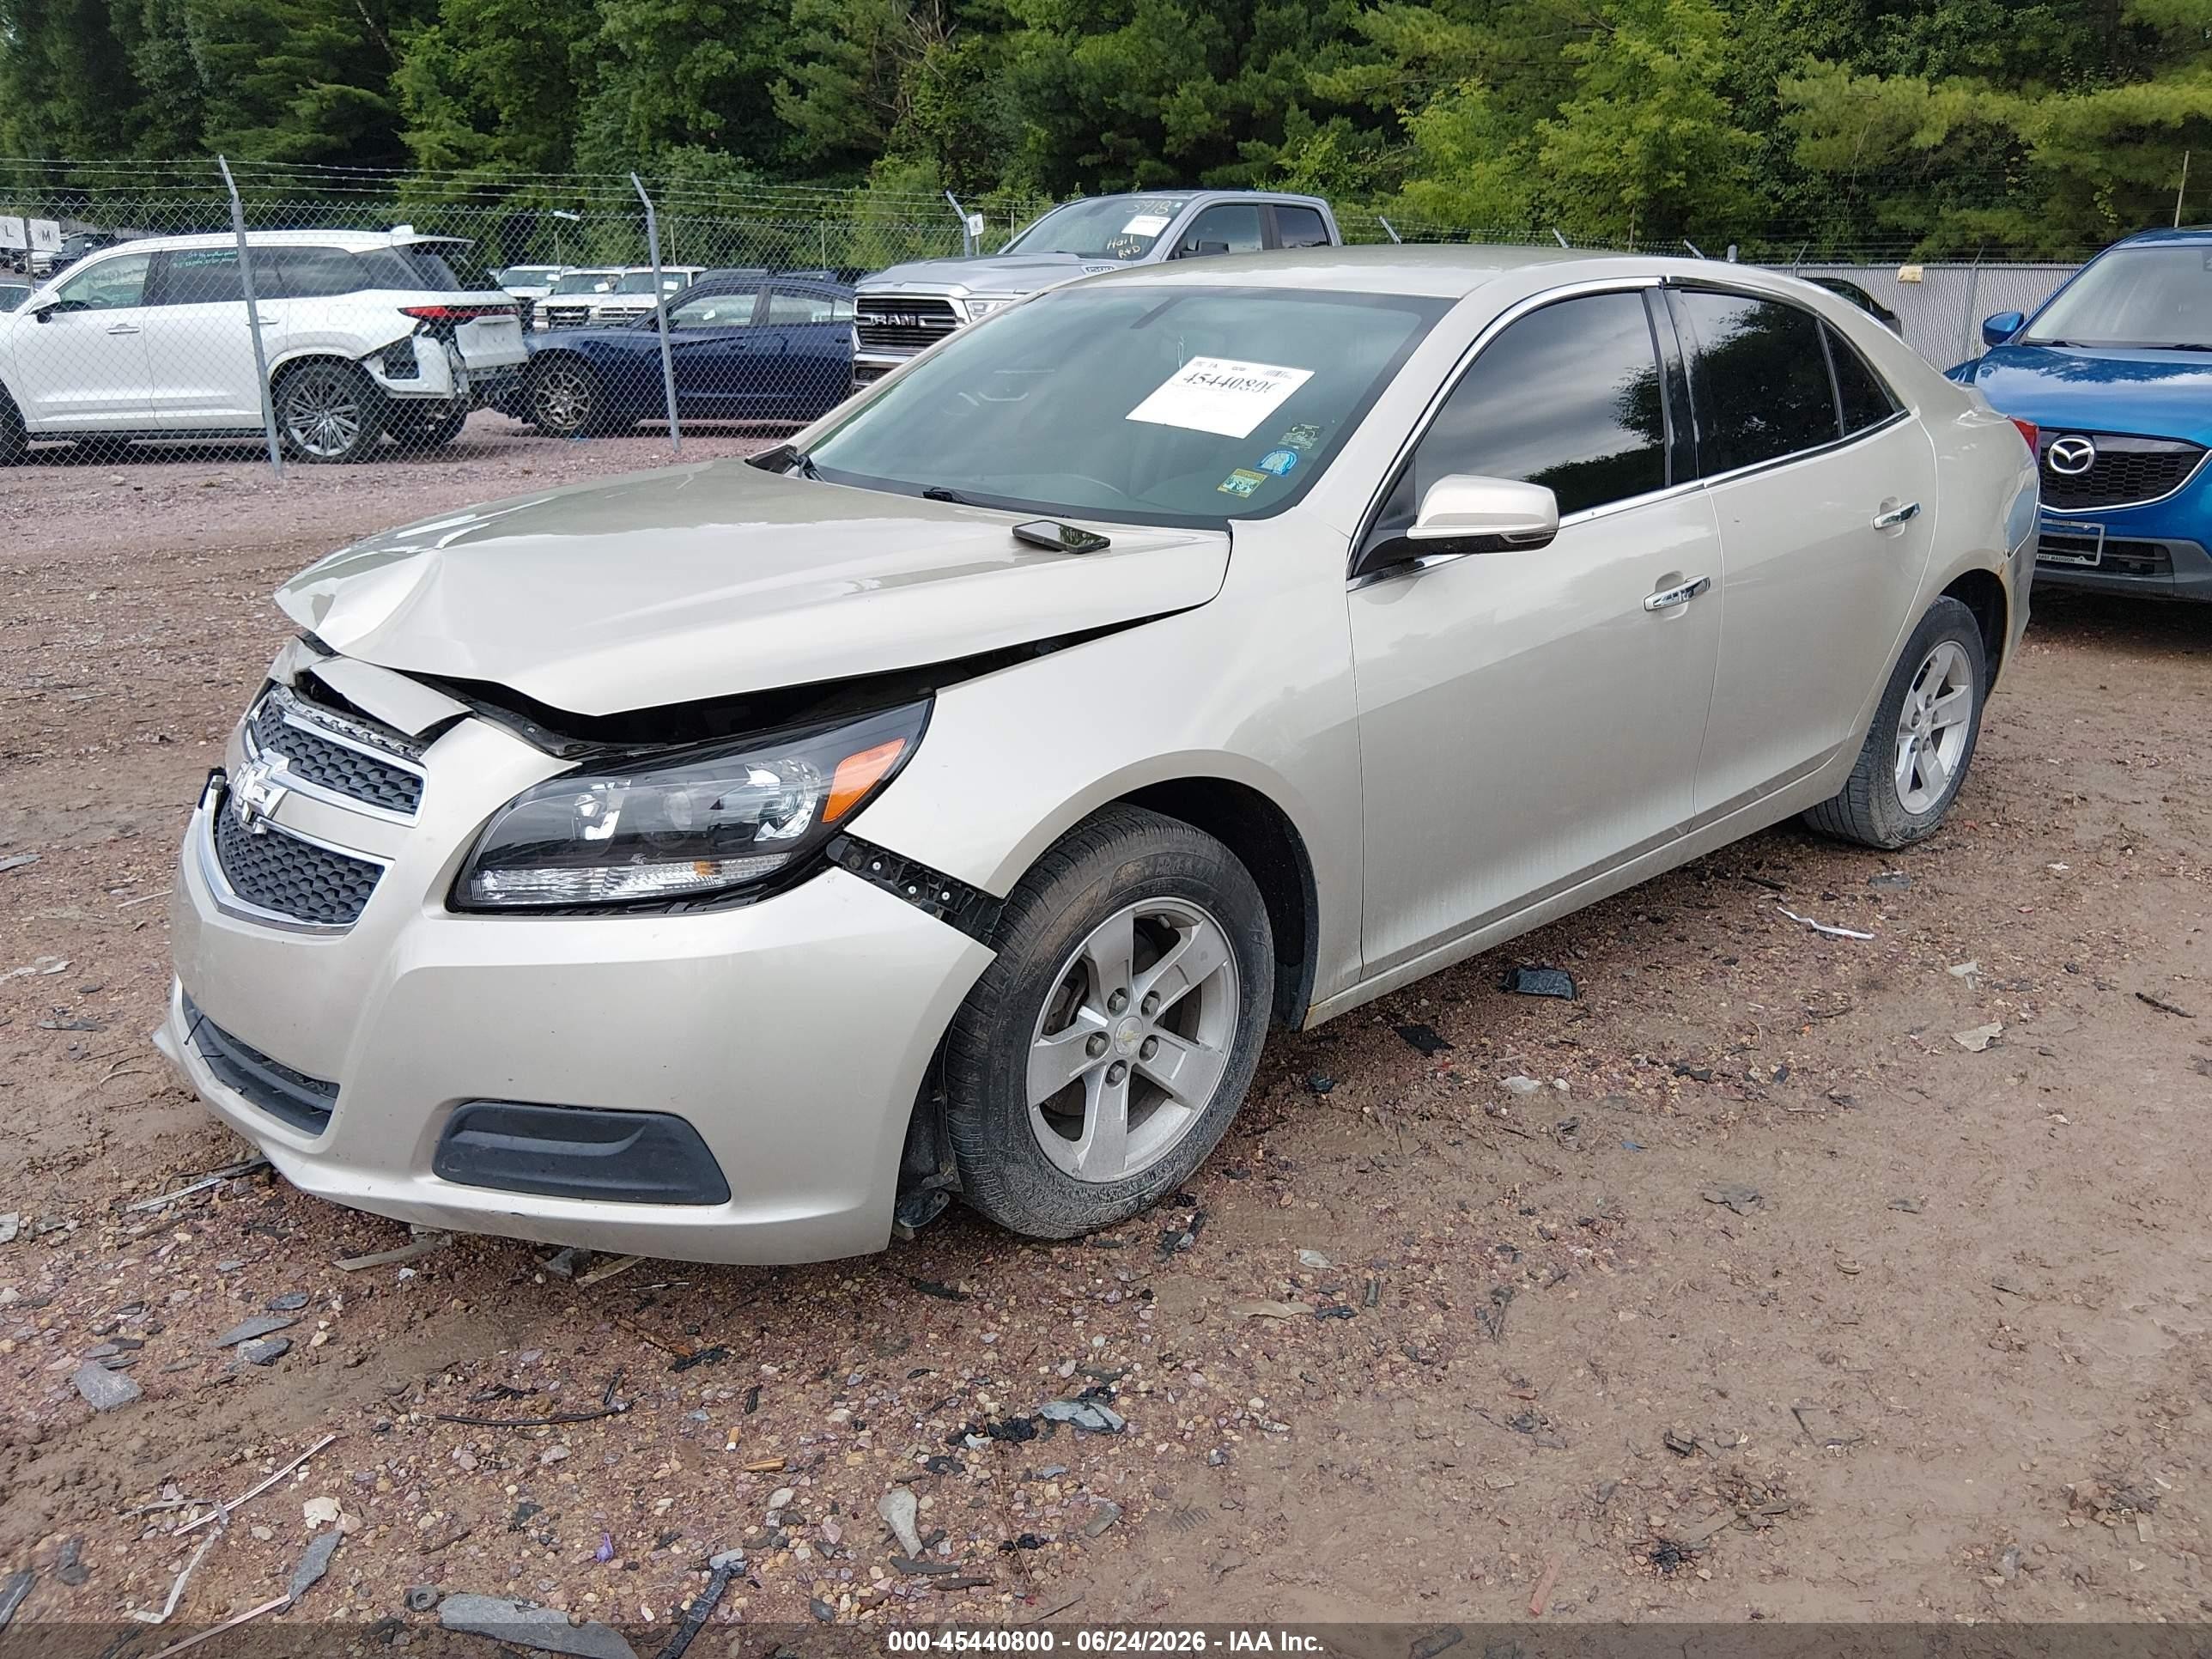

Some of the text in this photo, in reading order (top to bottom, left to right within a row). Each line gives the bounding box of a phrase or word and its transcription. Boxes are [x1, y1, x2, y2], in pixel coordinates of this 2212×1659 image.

[5, 225, 15, 238] L
[41, 230, 52, 242] M
[1107, 234, 1133, 250] Hail
[873, 314, 916, 325] RAM
